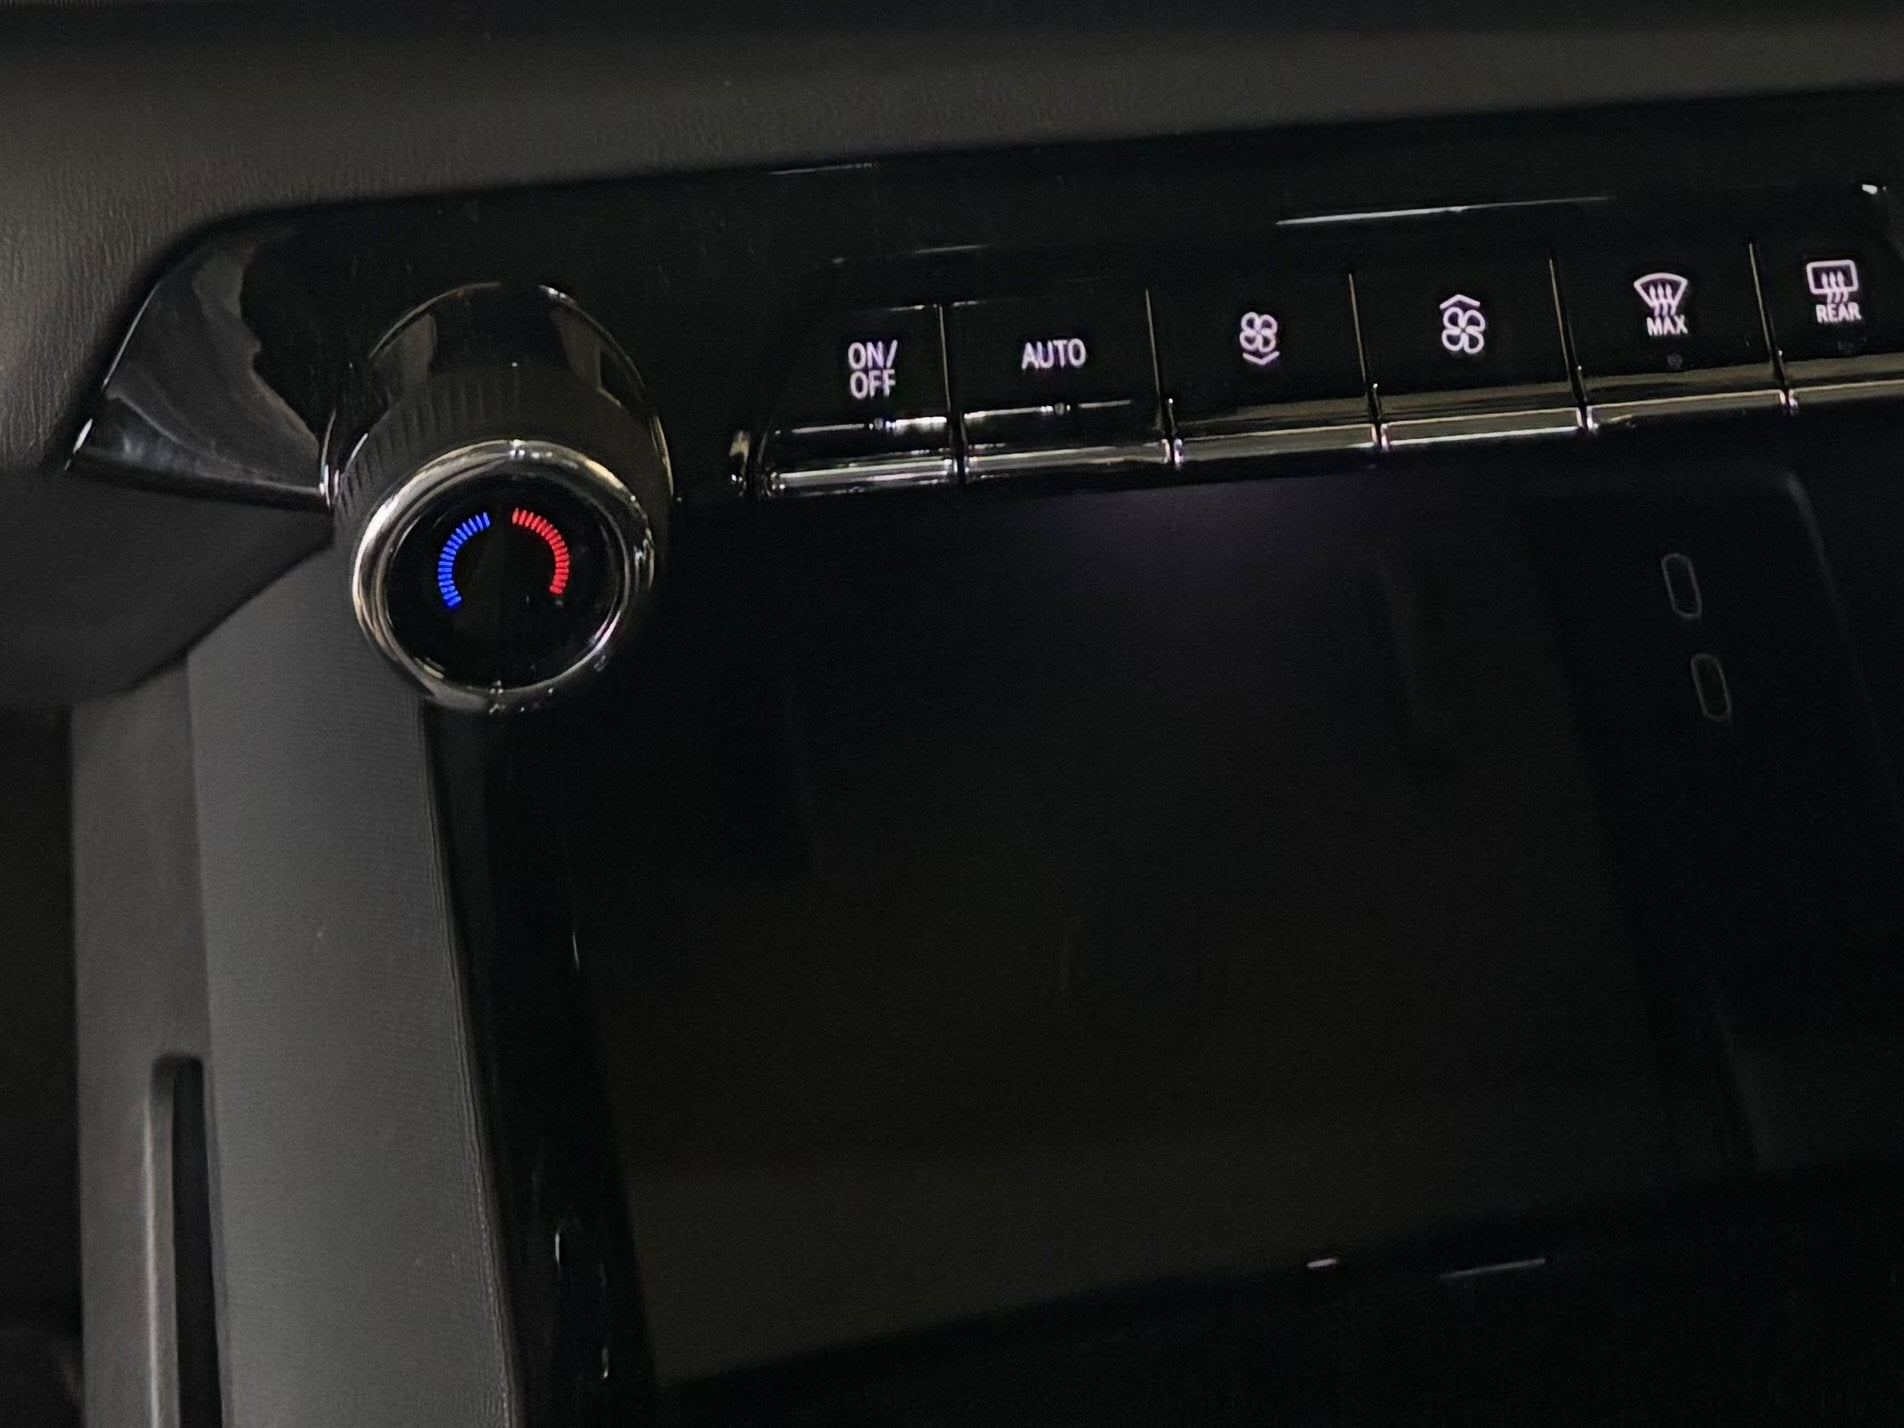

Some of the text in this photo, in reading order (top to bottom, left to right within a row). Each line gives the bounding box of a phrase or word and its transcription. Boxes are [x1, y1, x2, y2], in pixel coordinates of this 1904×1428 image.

[1646, 314, 1688, 336] MAX
[1815, 301, 1862, 323] REAR
[848, 340, 898, 370] ON/
[1021, 338, 1087, 370] AUTO
[850, 369, 896, 399] OFF
